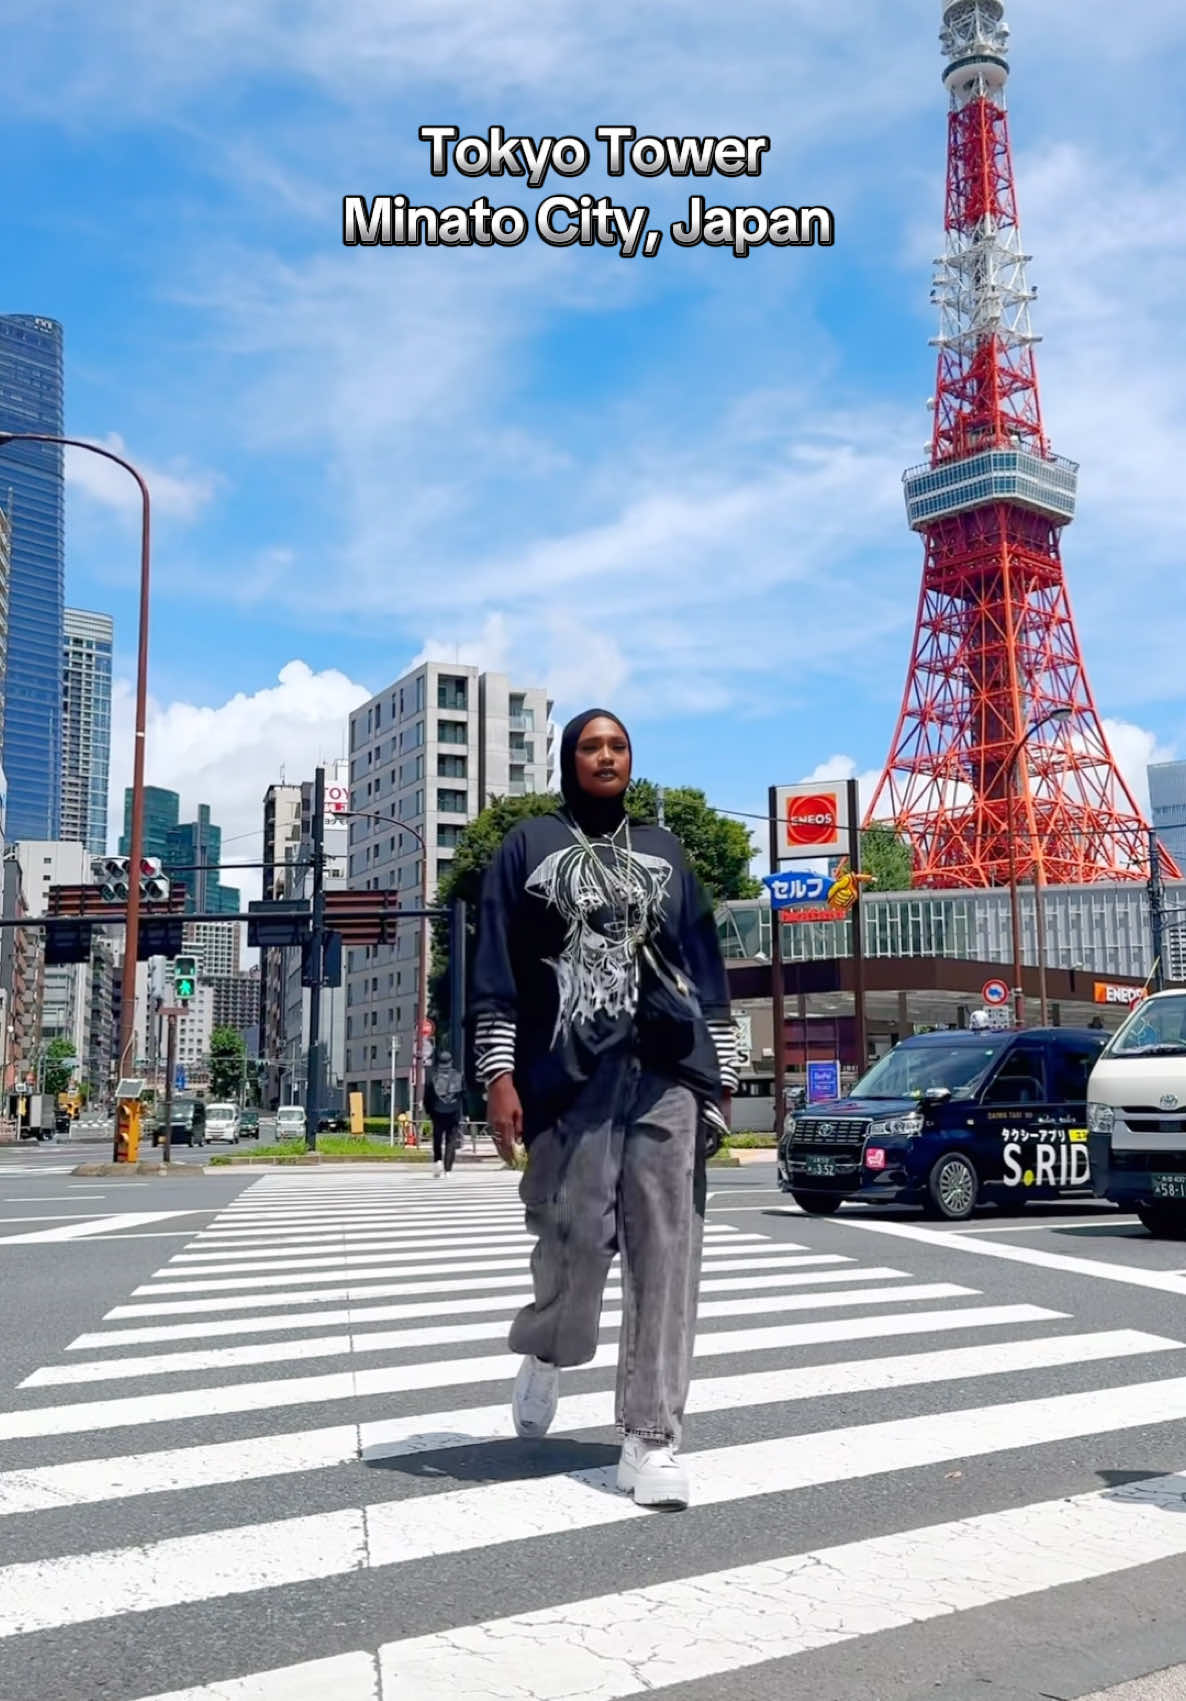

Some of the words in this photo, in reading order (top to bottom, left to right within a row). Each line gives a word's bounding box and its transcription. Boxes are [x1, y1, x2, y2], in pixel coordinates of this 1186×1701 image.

[791, 813, 832, 826] ENEOS
[771, 879, 823, 899] セルフ
[1002, 1128, 1066, 1142] タクシーアプリ
